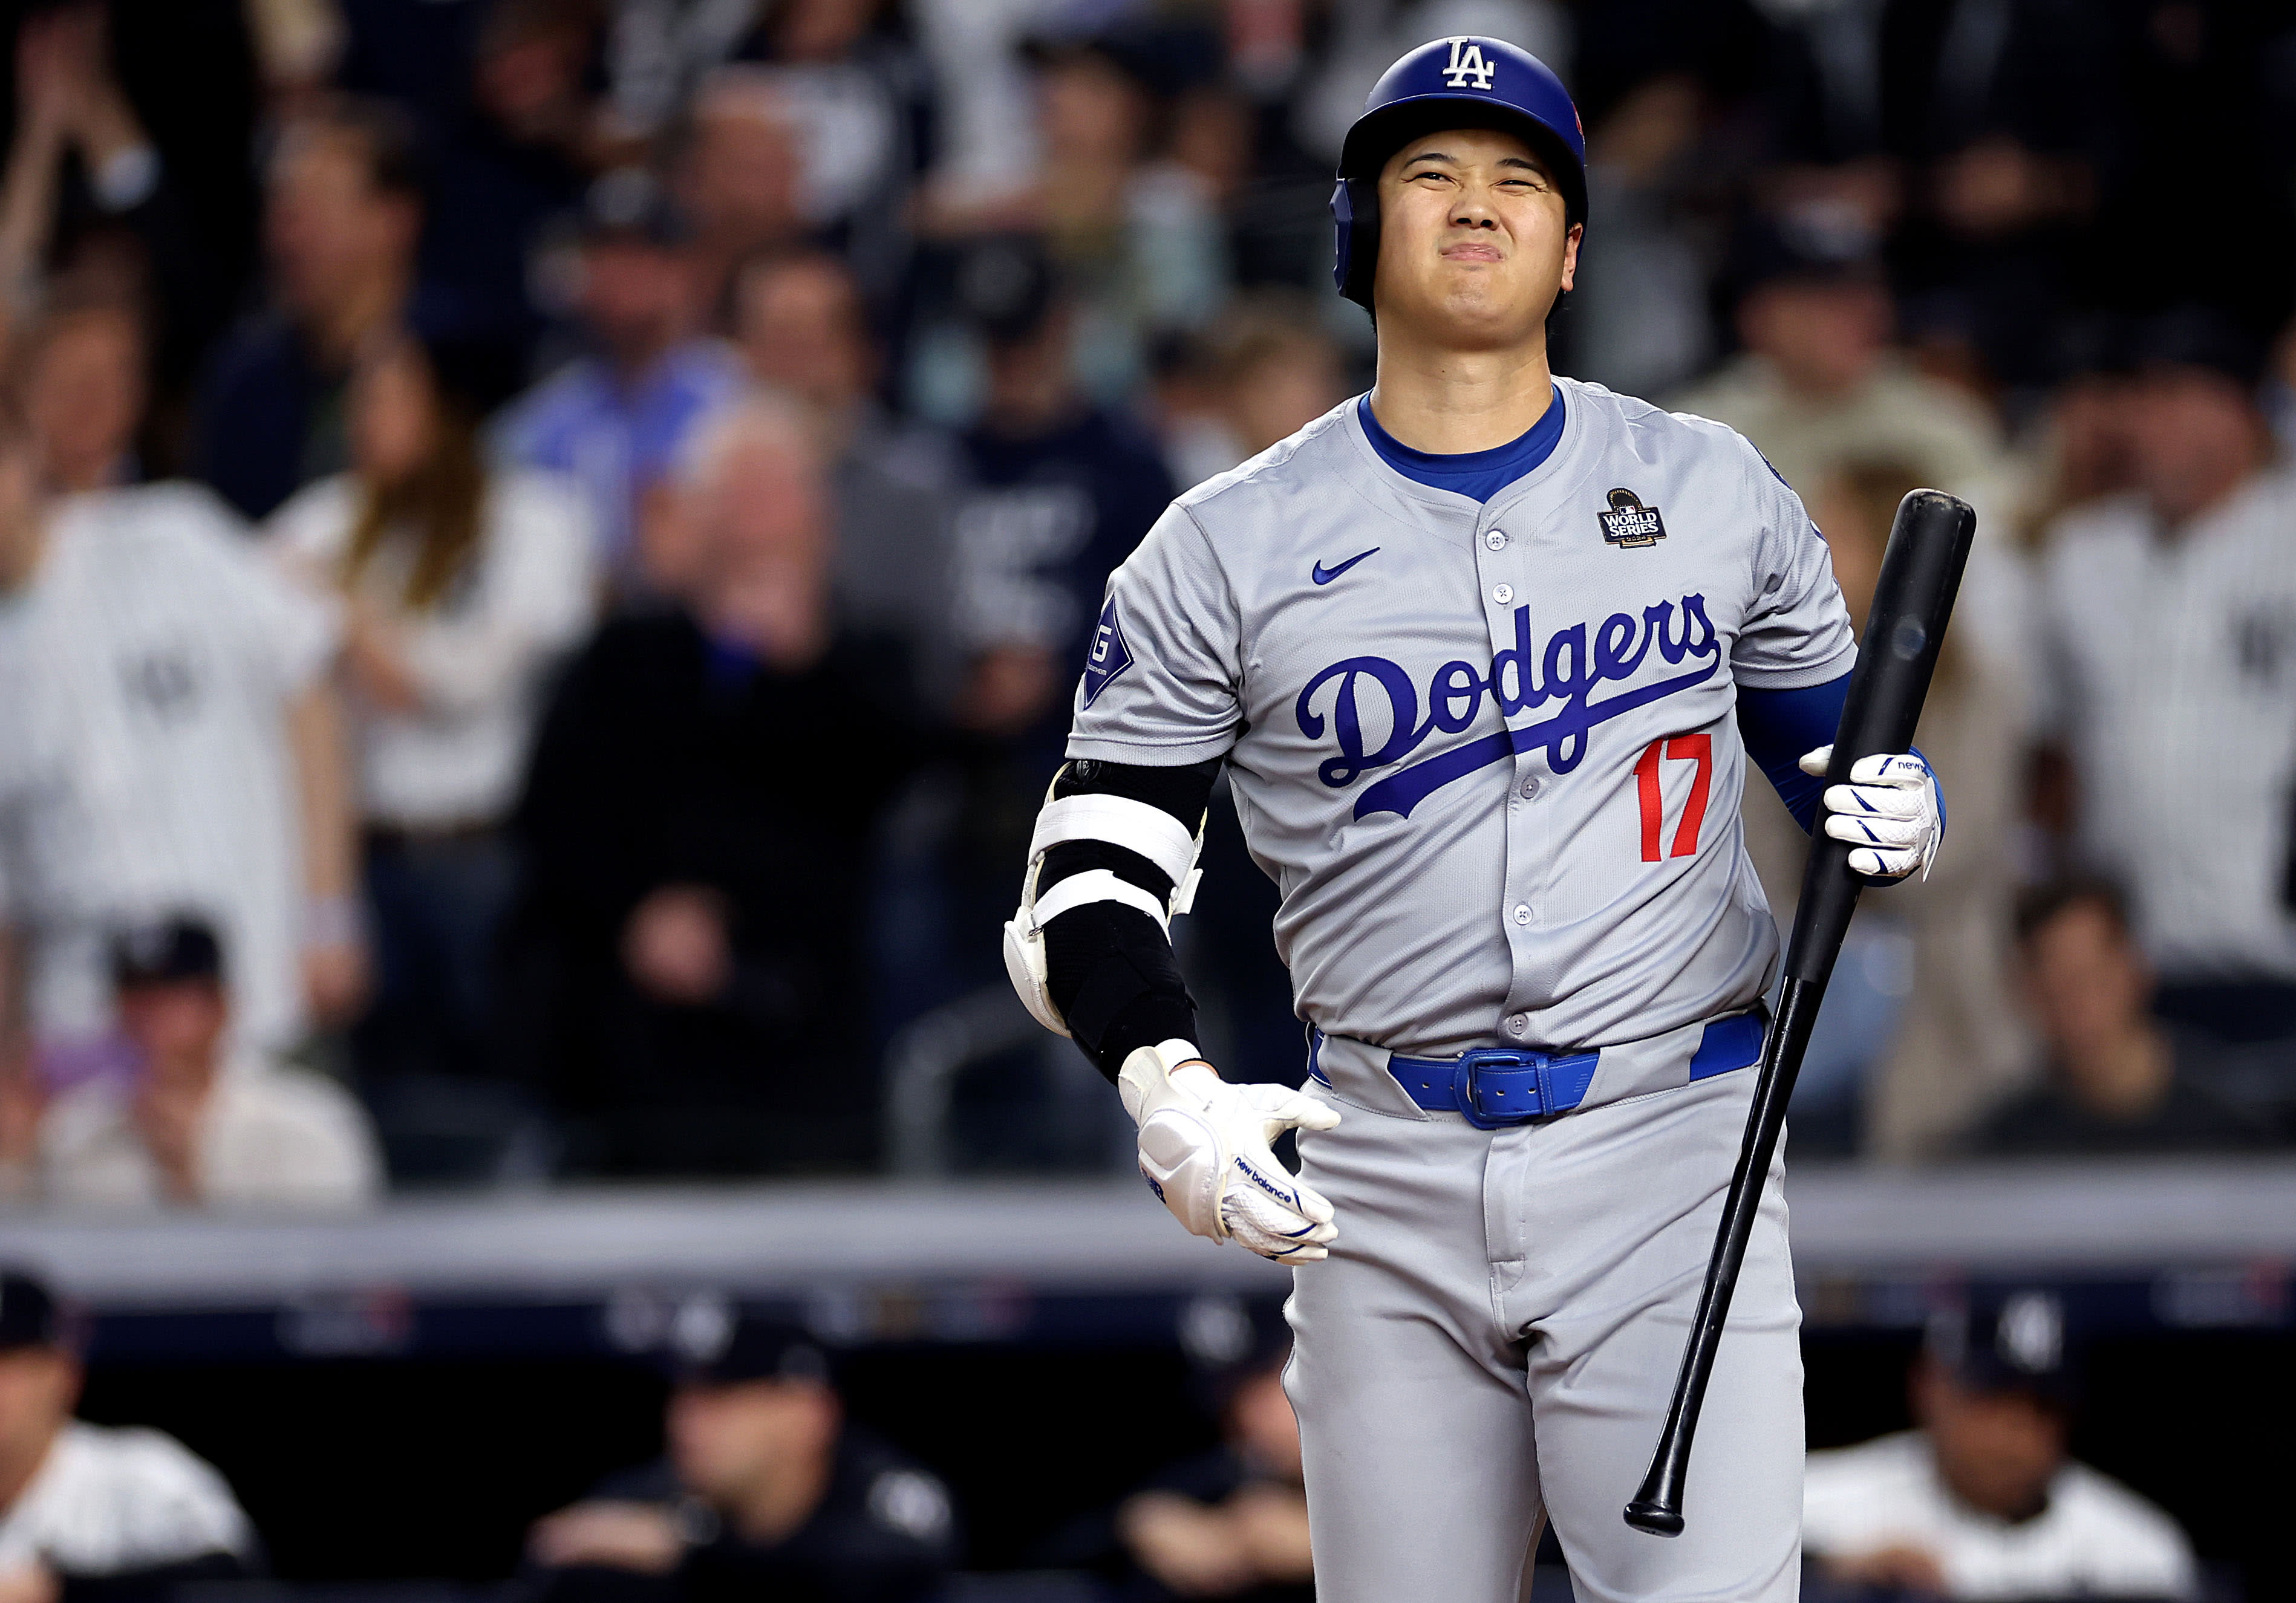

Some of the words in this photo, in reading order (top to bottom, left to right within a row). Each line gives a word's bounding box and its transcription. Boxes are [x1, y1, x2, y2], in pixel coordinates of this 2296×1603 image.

[1443, 39, 1495, 89] LA
[1603, 512, 1657, 527] WORLD
[1609, 522, 1659, 537] SERIES
[1092, 624, 1112, 663] G
[1296, 593, 1721, 787] Dodgers
[1633, 733, 1712, 862] 17
[1234, 1156, 1252, 1176] new
[1251, 1171, 1291, 1203] balance
